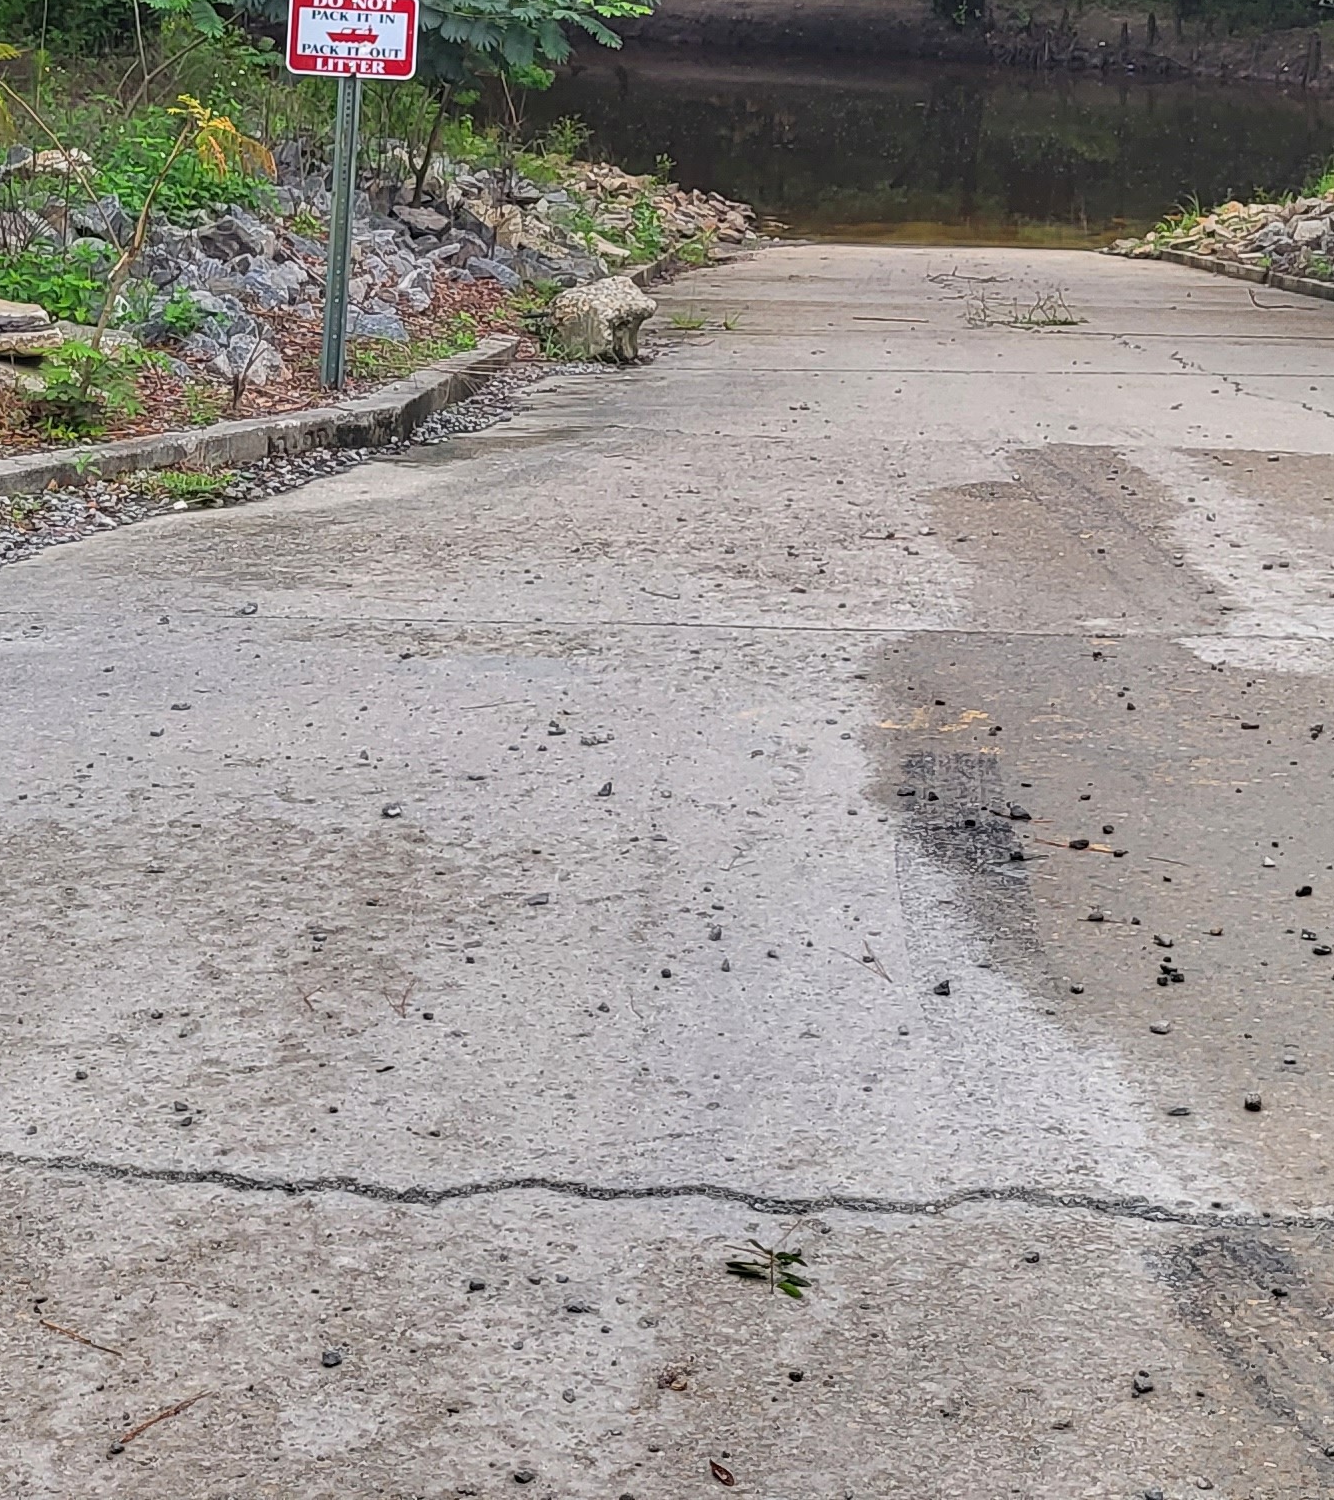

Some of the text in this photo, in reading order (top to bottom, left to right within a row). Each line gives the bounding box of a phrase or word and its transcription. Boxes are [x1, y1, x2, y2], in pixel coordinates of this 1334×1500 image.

[311, 9, 396, 24] PACK IT IN
[301, 43, 402, 59] PACK IT OUT
[315, 57, 386, 74] LITTER
